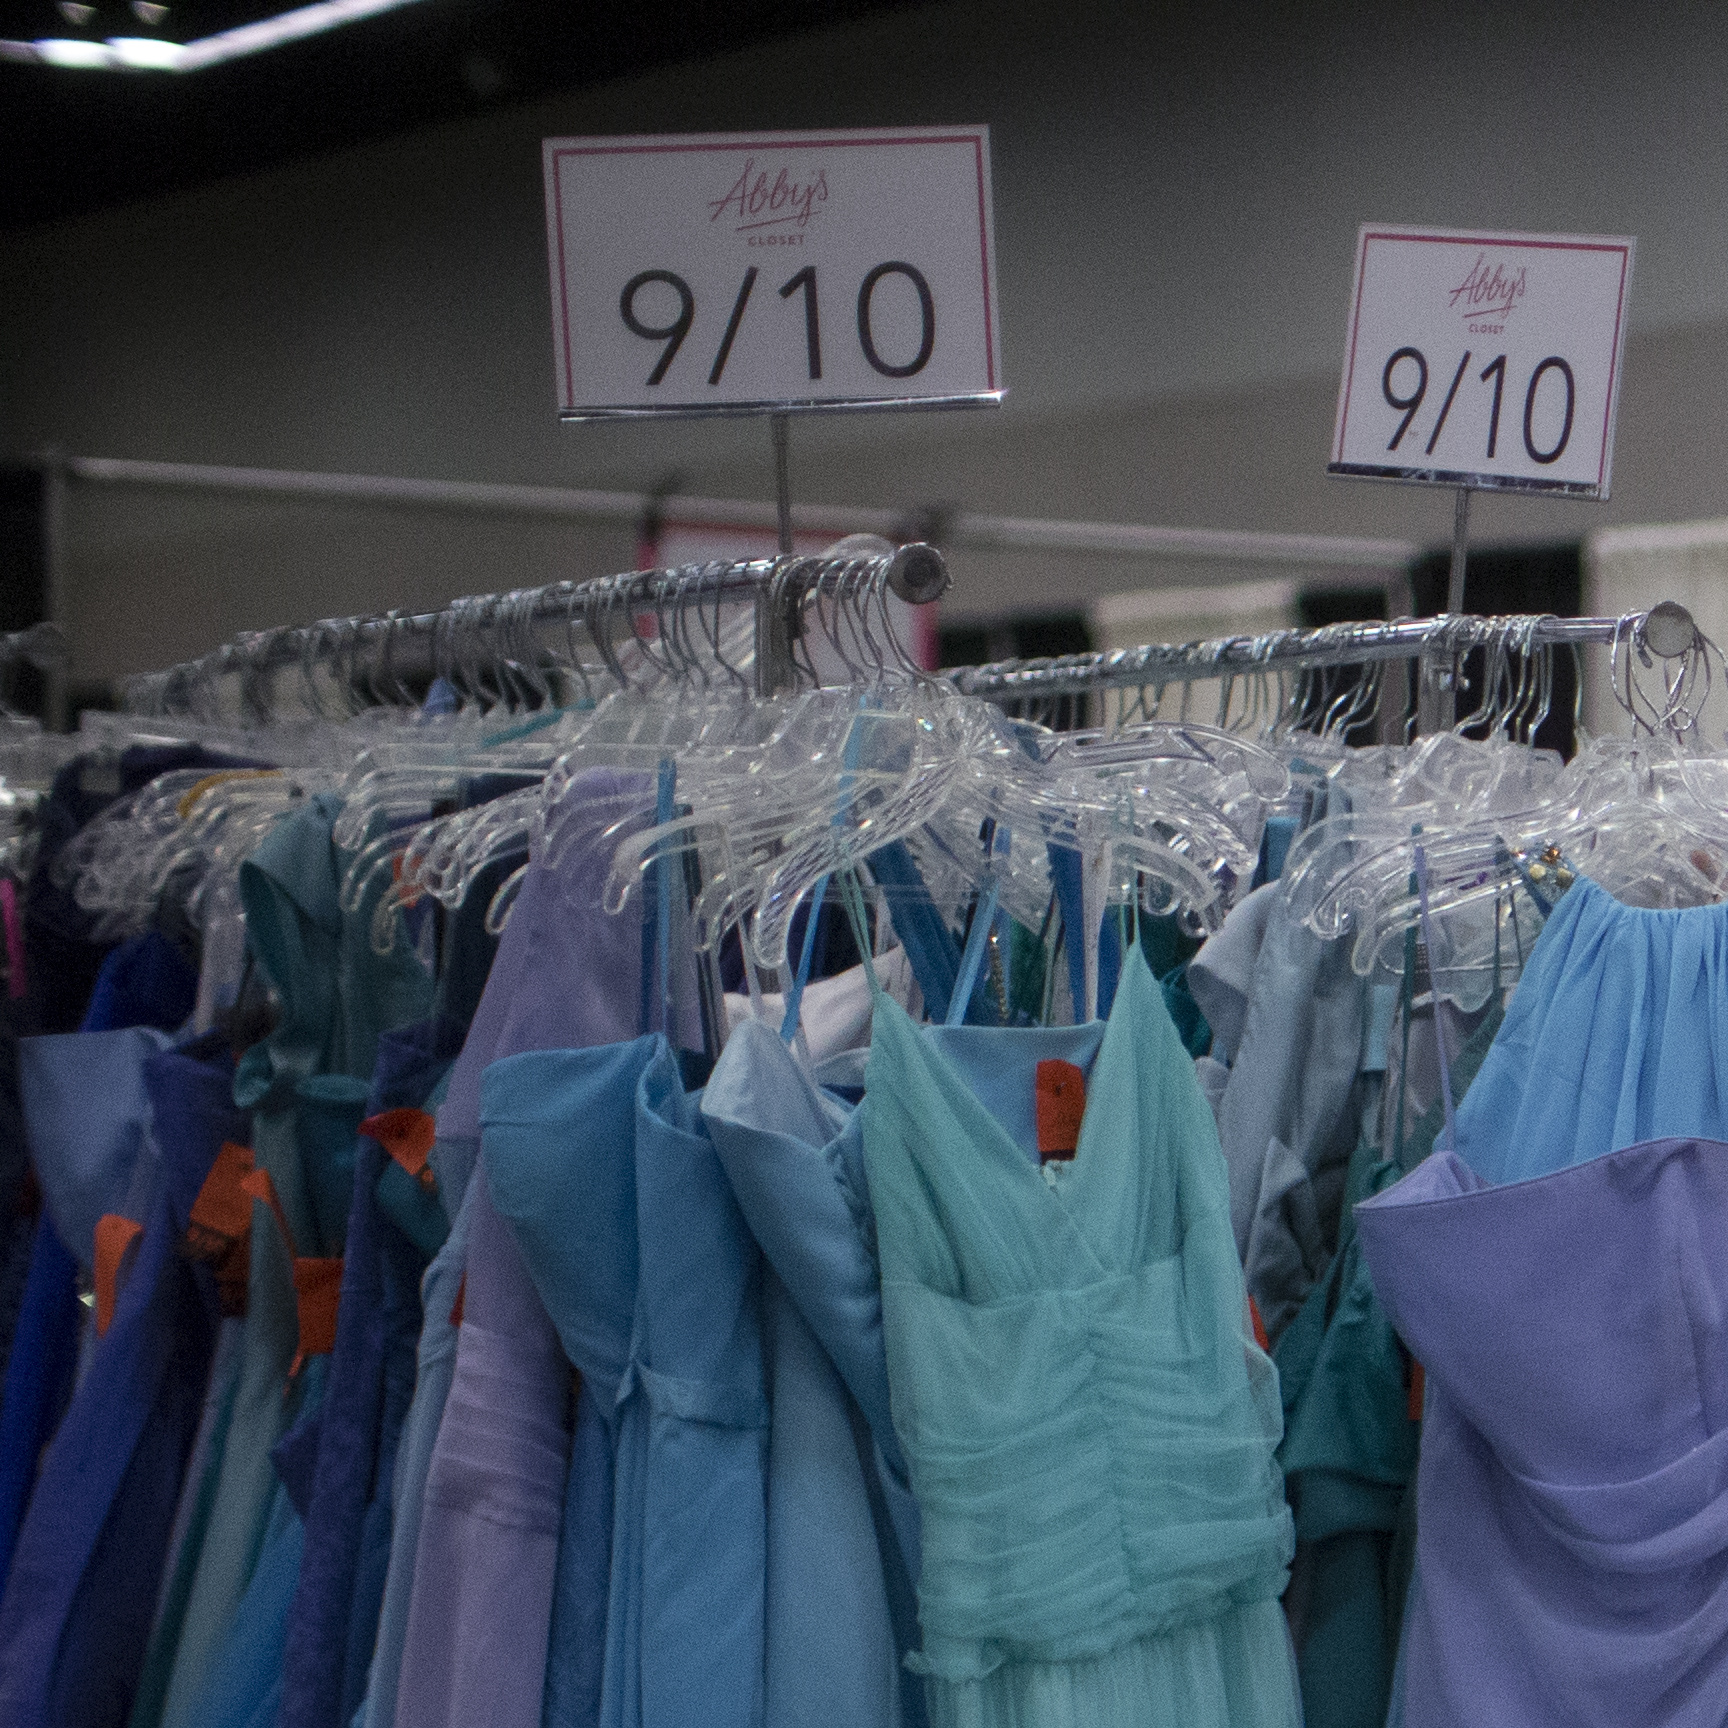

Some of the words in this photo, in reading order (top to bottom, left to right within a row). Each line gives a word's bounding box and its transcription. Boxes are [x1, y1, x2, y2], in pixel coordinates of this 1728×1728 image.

[707, 156, 829, 228] Abby's
[746, 233, 806, 247] CLOSET
[1448, 251, 1527, 320] Abby's
[618, 260, 936, 387] 9/10
[1468, 322, 1505, 335] CLOSET
[1381, 346, 1576, 465] 9/10
